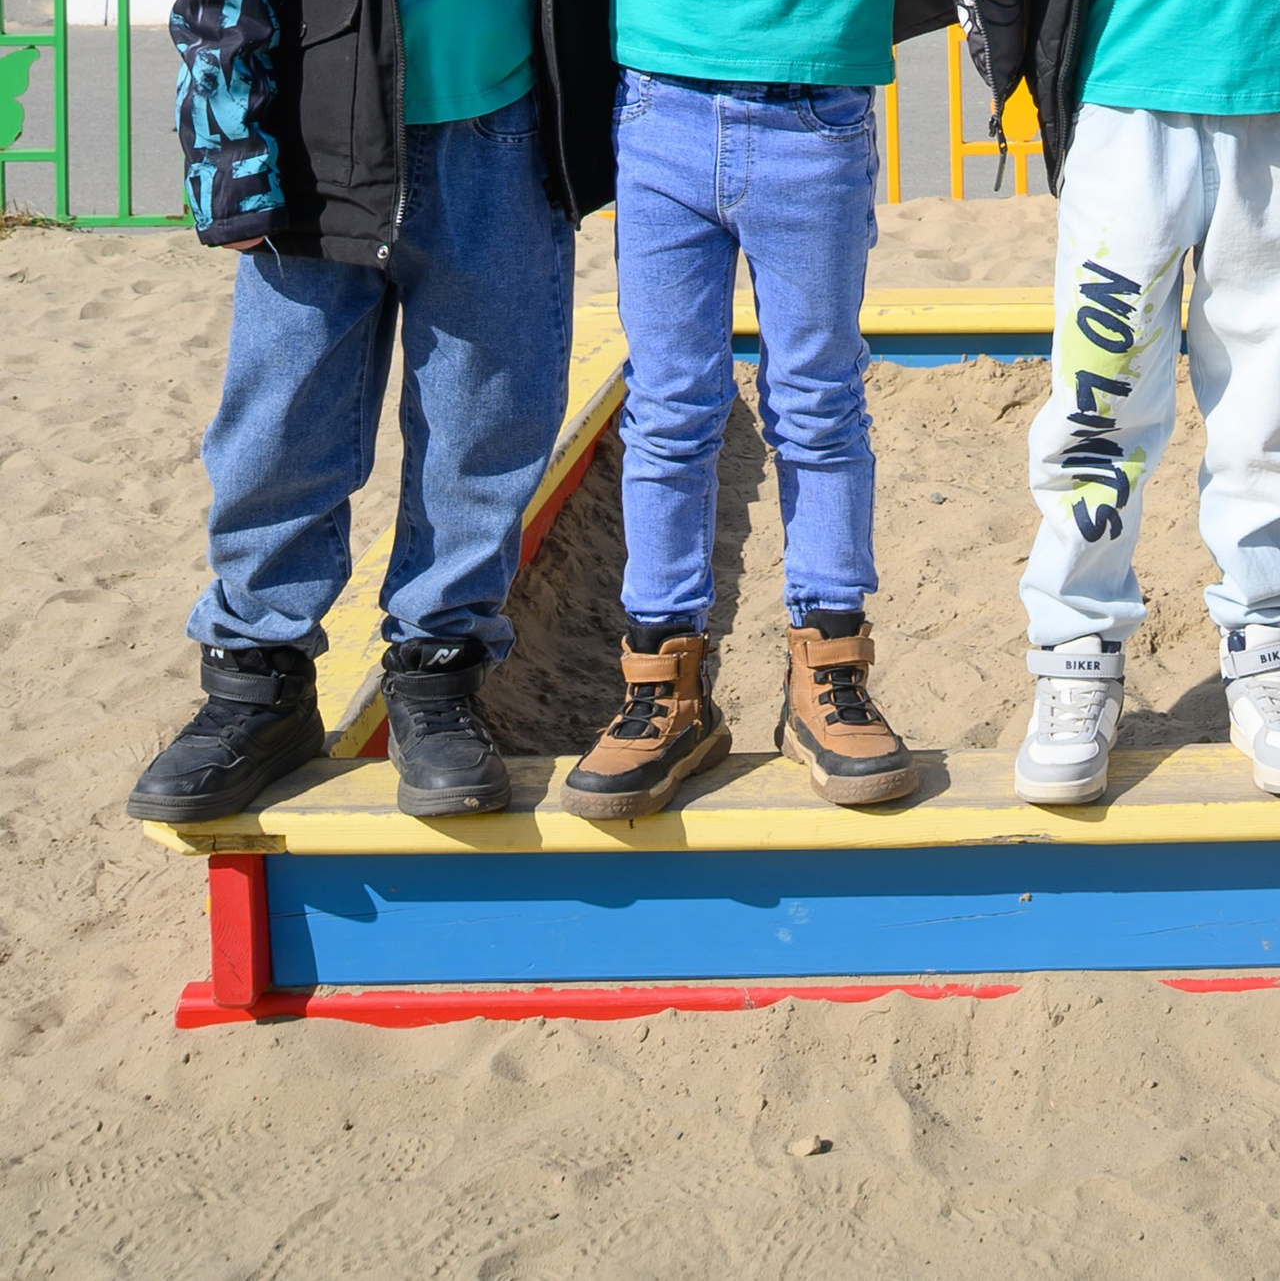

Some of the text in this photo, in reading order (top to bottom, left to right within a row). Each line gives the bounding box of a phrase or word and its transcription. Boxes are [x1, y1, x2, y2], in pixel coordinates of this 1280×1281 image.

[1060, 259, 1142, 543] NO LIMITS
[1064, 659, 1101, 671] BIKER
